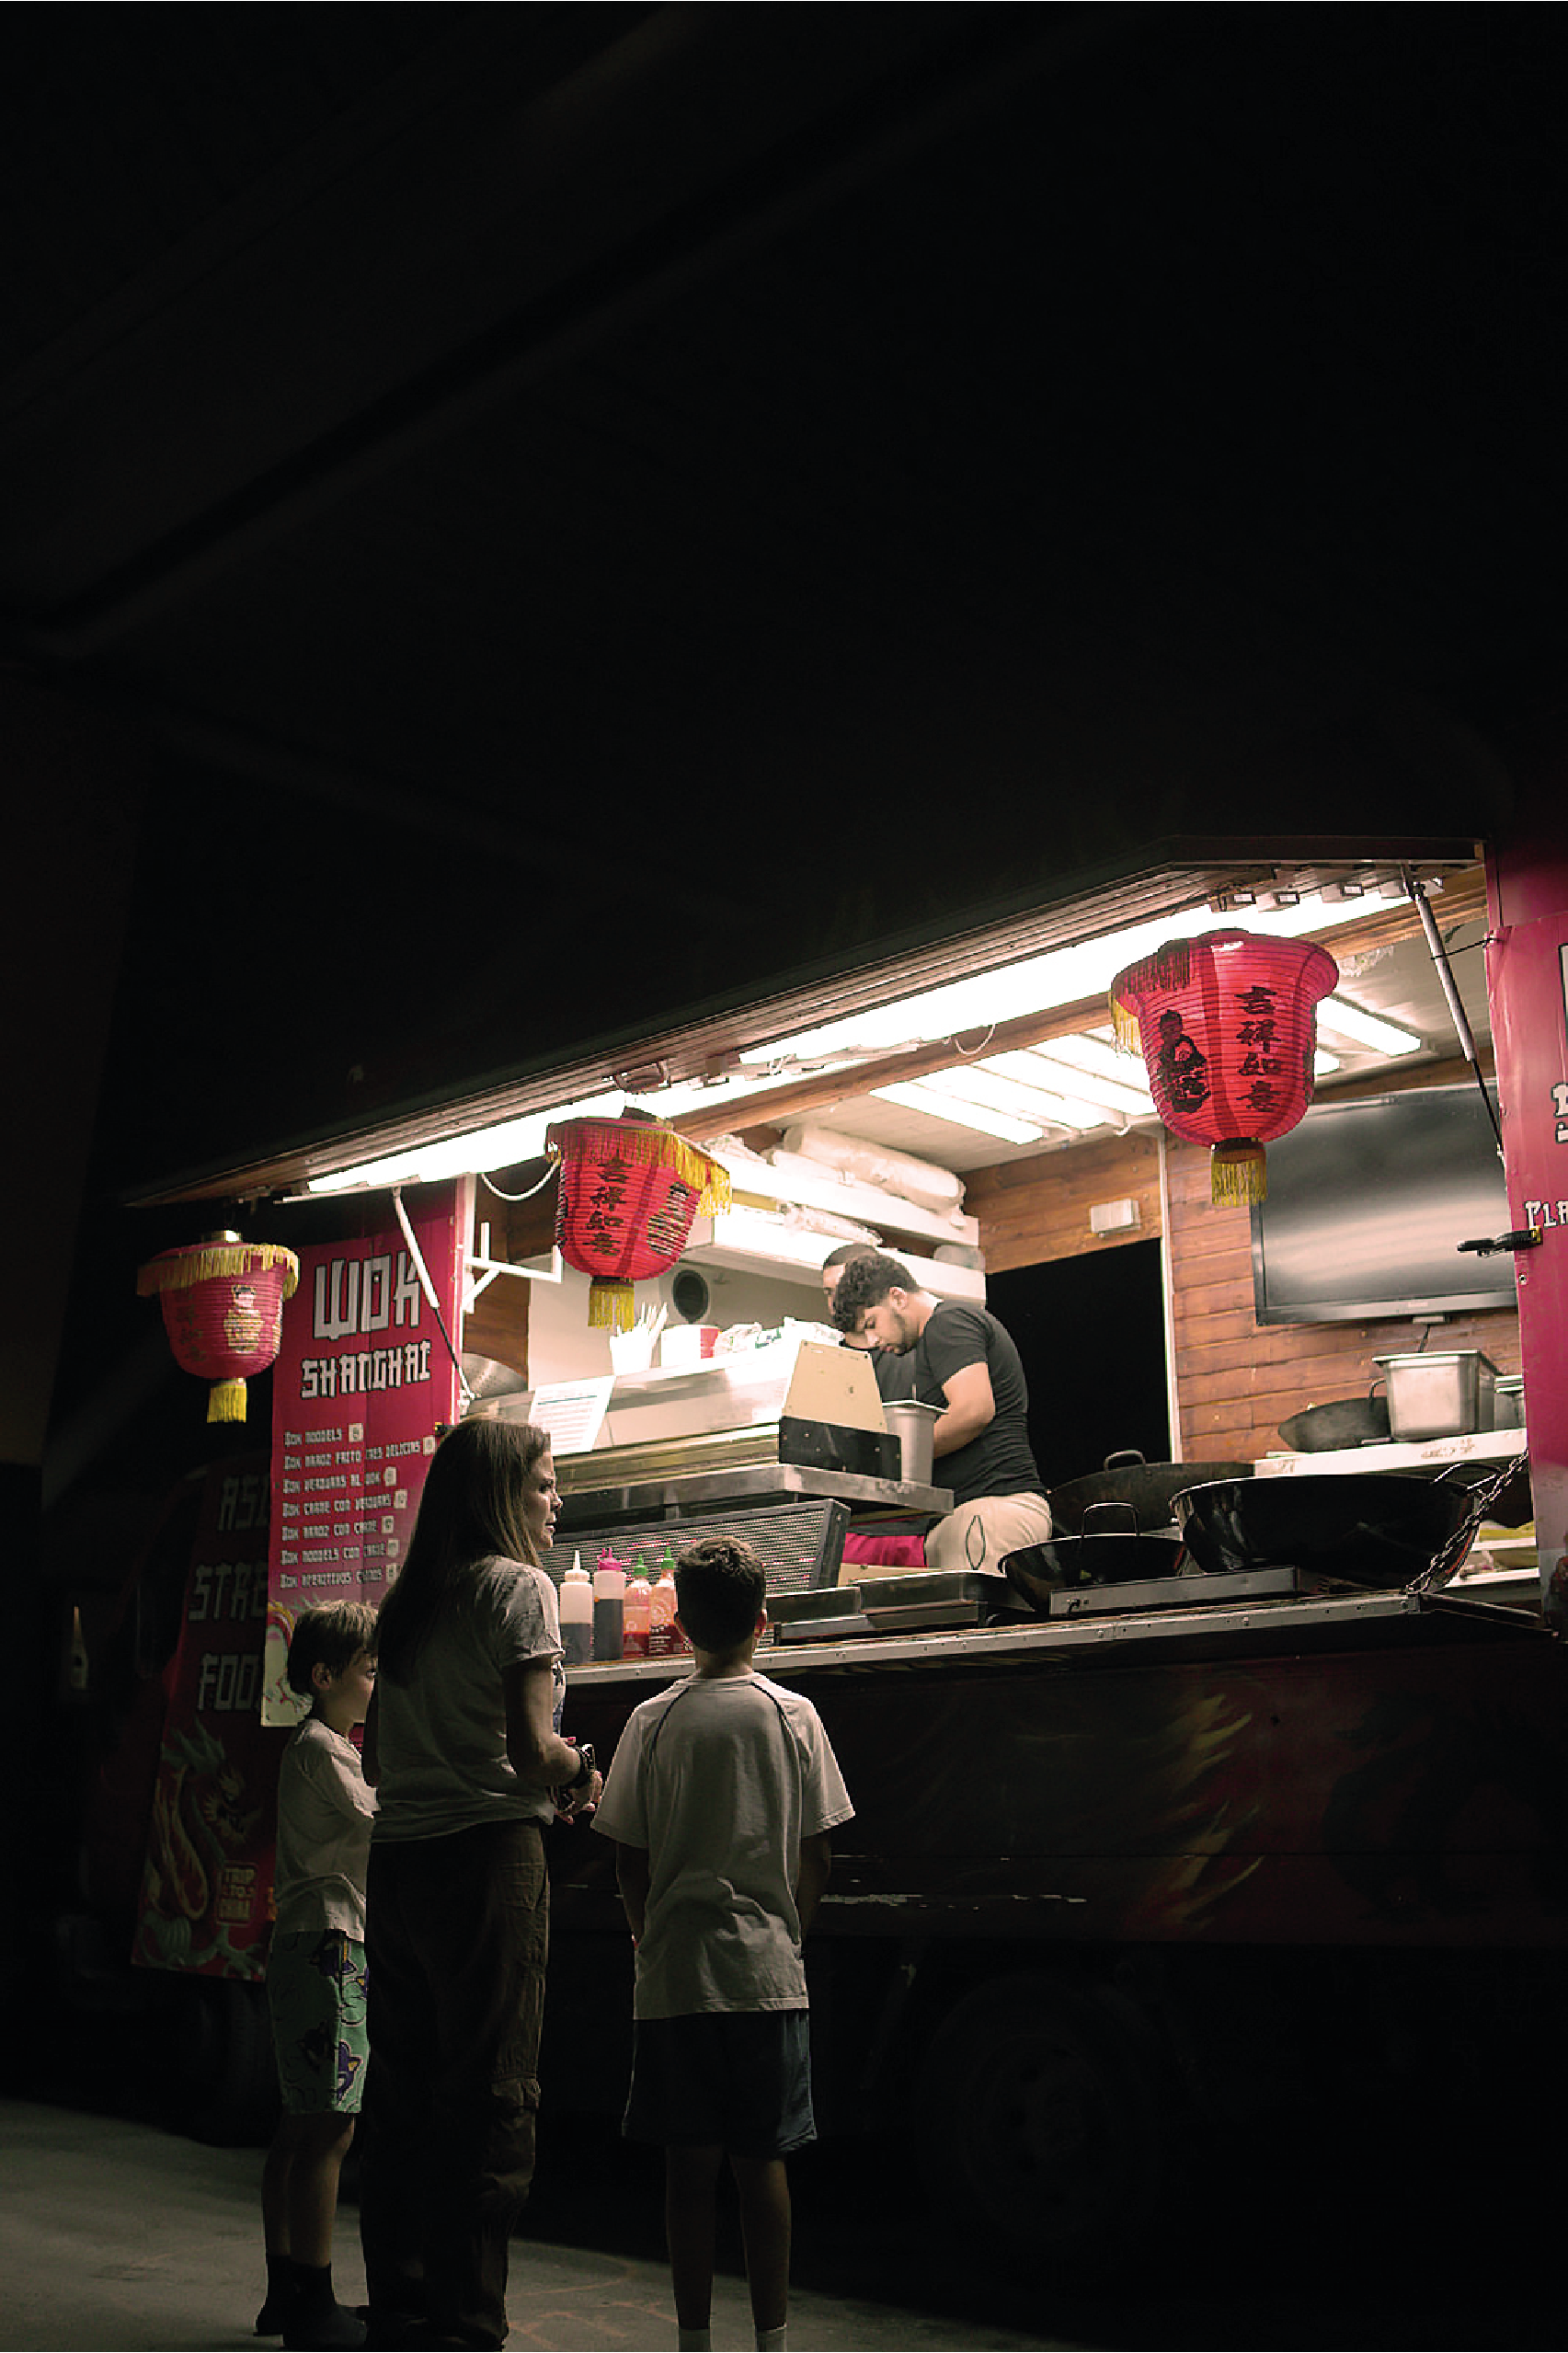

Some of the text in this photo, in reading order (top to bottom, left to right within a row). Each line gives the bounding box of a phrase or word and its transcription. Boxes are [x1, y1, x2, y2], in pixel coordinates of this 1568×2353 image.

[313, 1250, 421, 1341] WOK
[301, 1339, 431, 1400] SHANGHAI
[196, 1652, 261, 1713] FOO
